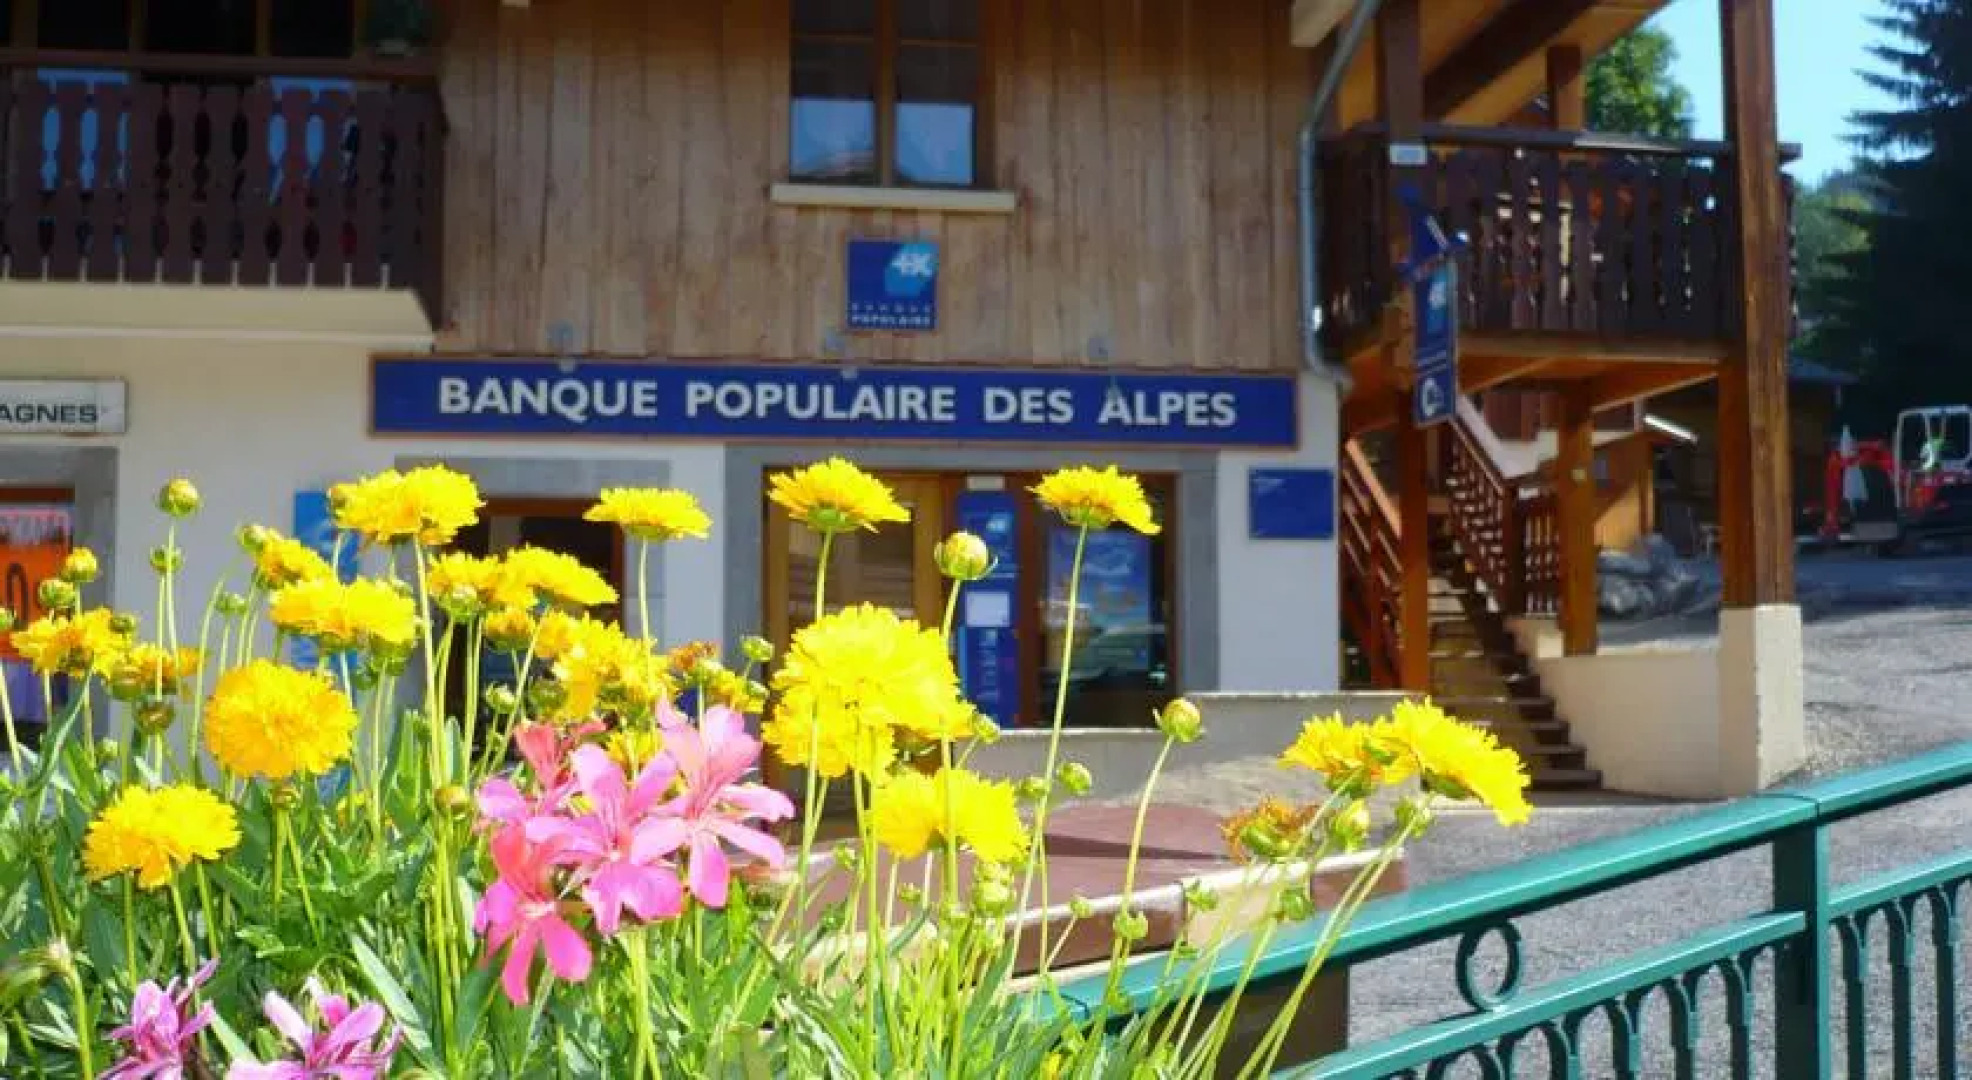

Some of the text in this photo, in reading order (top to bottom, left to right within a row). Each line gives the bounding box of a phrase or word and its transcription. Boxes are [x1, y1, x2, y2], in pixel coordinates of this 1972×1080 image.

[439, 377, 1237, 427] BANQUE POPULAIRE DES ALPES
